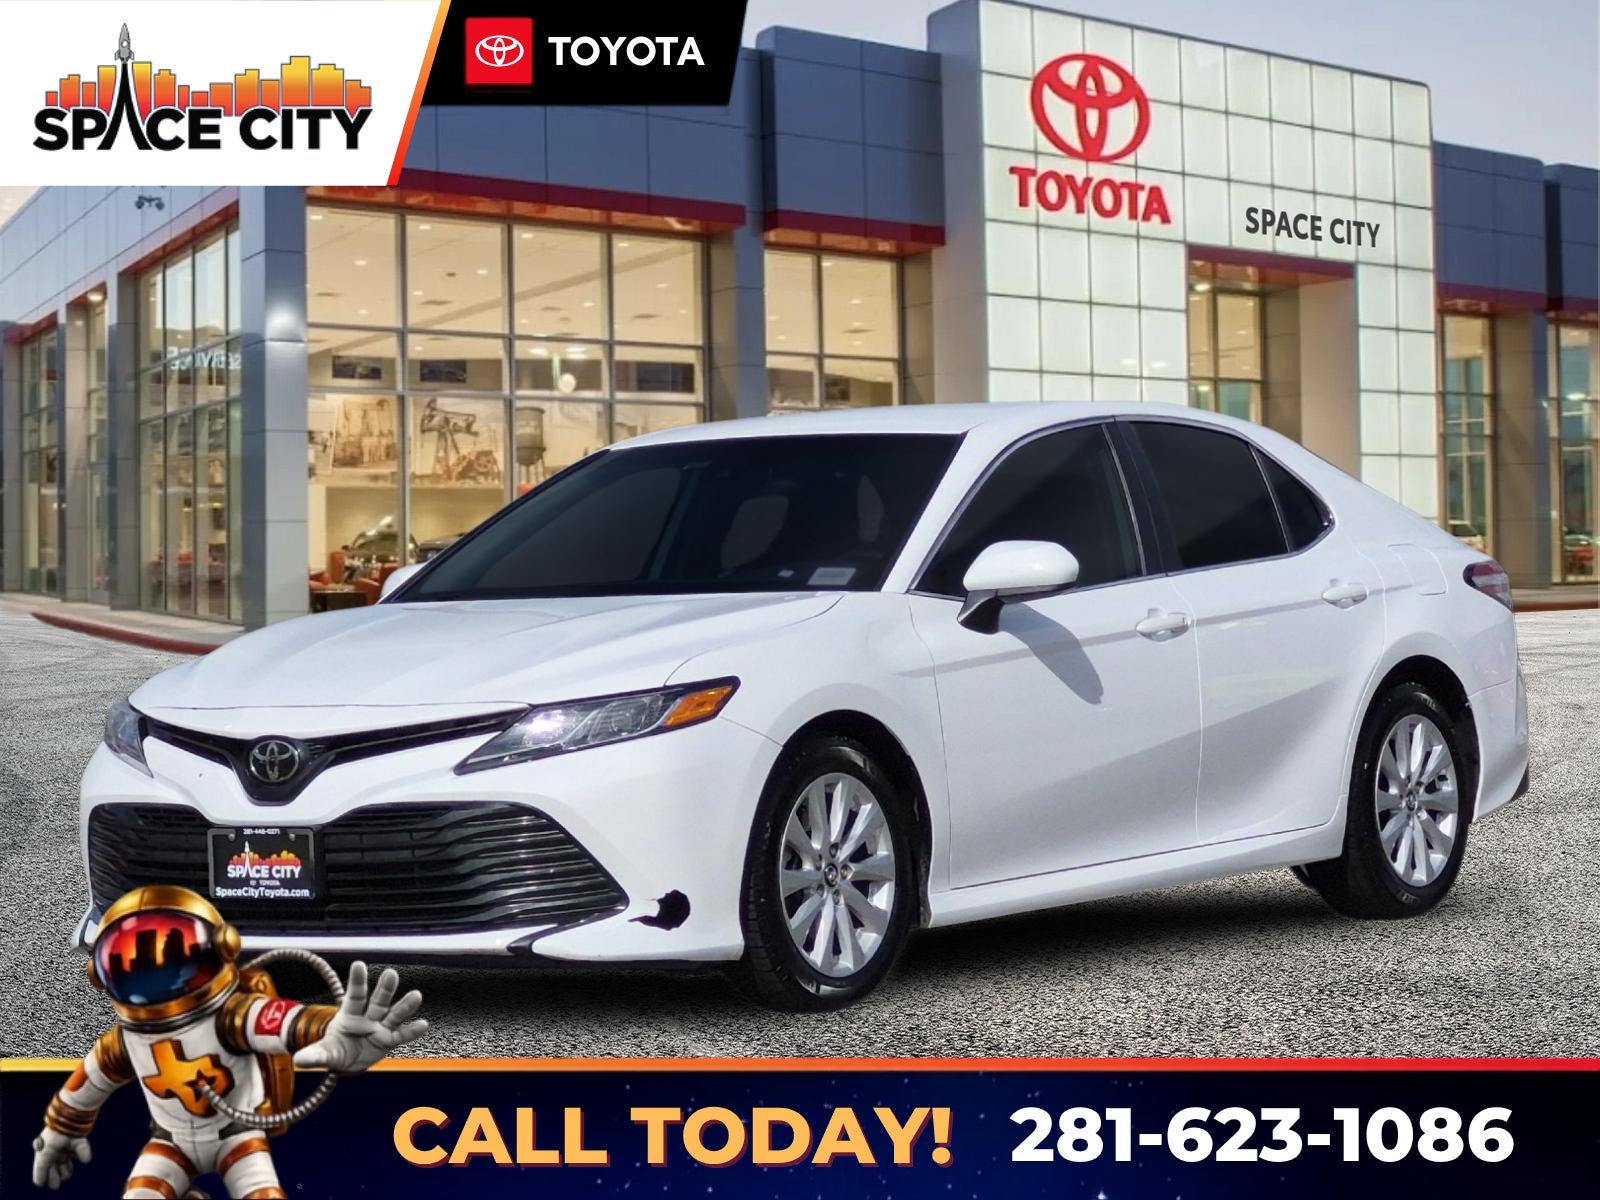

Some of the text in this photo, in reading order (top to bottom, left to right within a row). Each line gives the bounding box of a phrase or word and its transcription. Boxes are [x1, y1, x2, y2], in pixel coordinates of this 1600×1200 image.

[1009, 166, 1172, 224] TOYOTA
[1244, 206, 1381, 248] SPACE CITY
[227, 864, 302, 879] SPACE CITY
[215, 886, 310, 899] SpaceCityToyota.com
